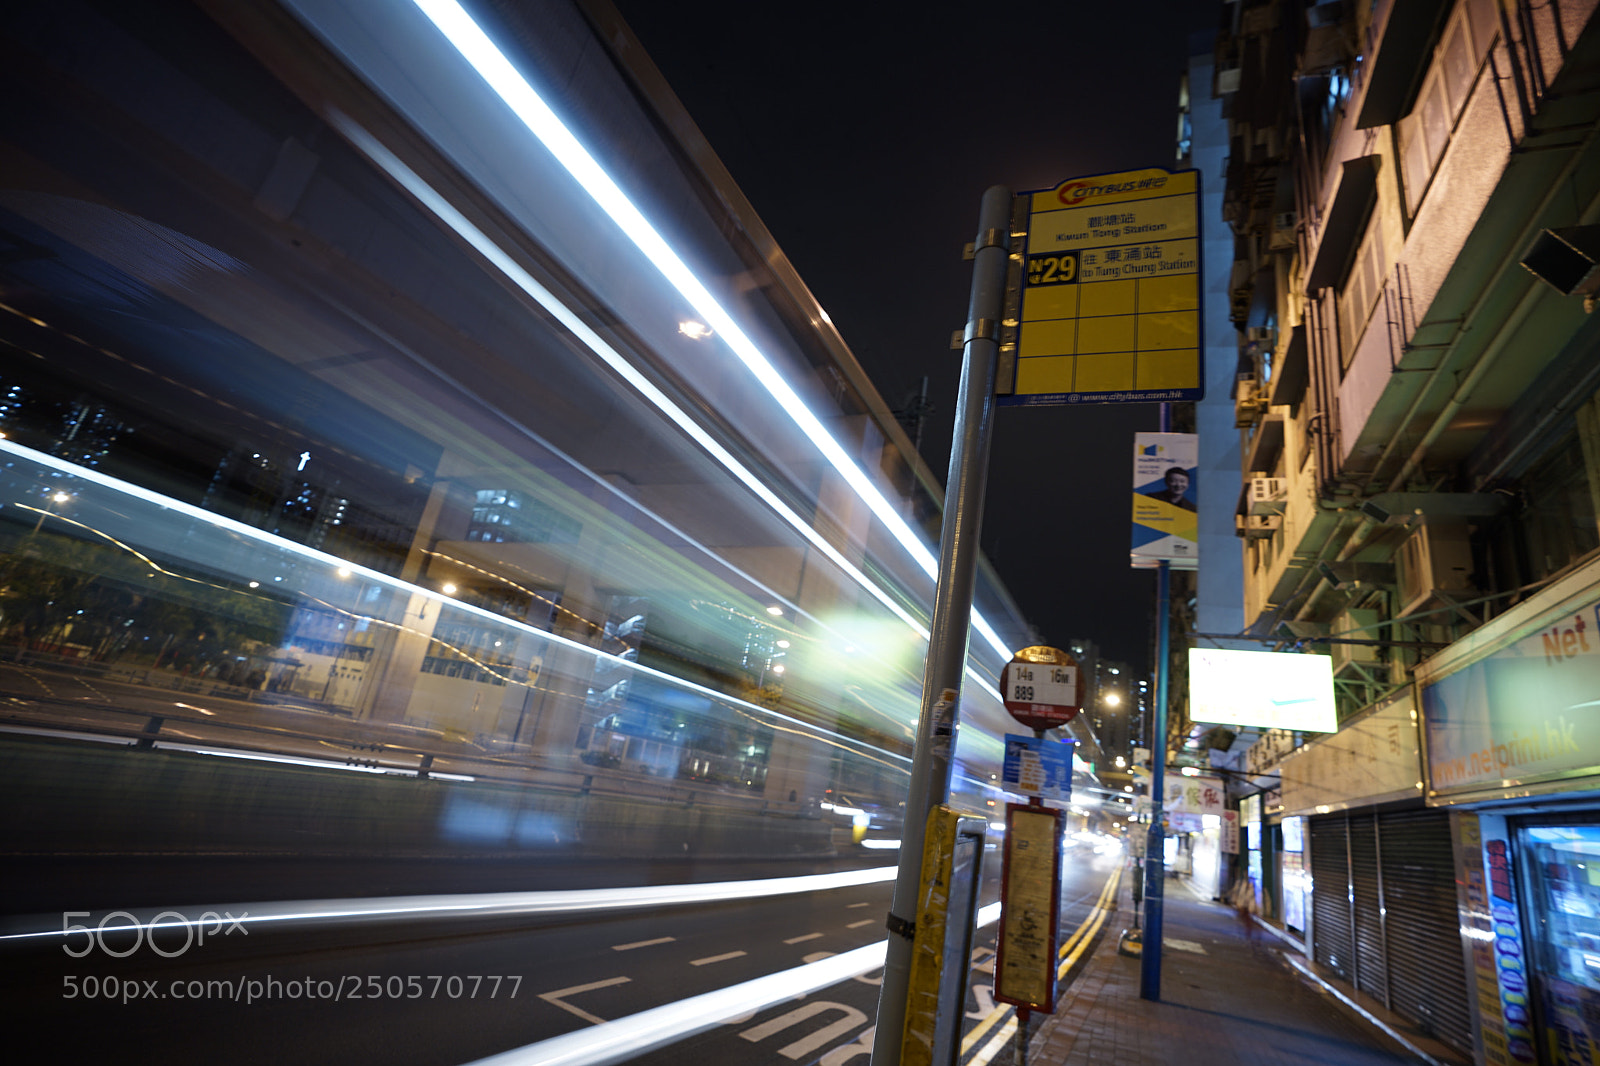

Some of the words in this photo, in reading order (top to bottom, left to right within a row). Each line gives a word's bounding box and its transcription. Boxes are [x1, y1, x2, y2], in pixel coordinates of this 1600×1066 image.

[1056, 232, 1089, 242] Kwun
[1092, 228, 1121, 238] Tong
[1123, 223, 1167, 234] Station
[1095, 265, 1120, 277] Tung
[1122, 262, 1157, 275] Chung
[1158, 257, 1196, 271] Station
[1541, 614, 1591, 667] Net
[1015, 686, 1034, 700] 889
